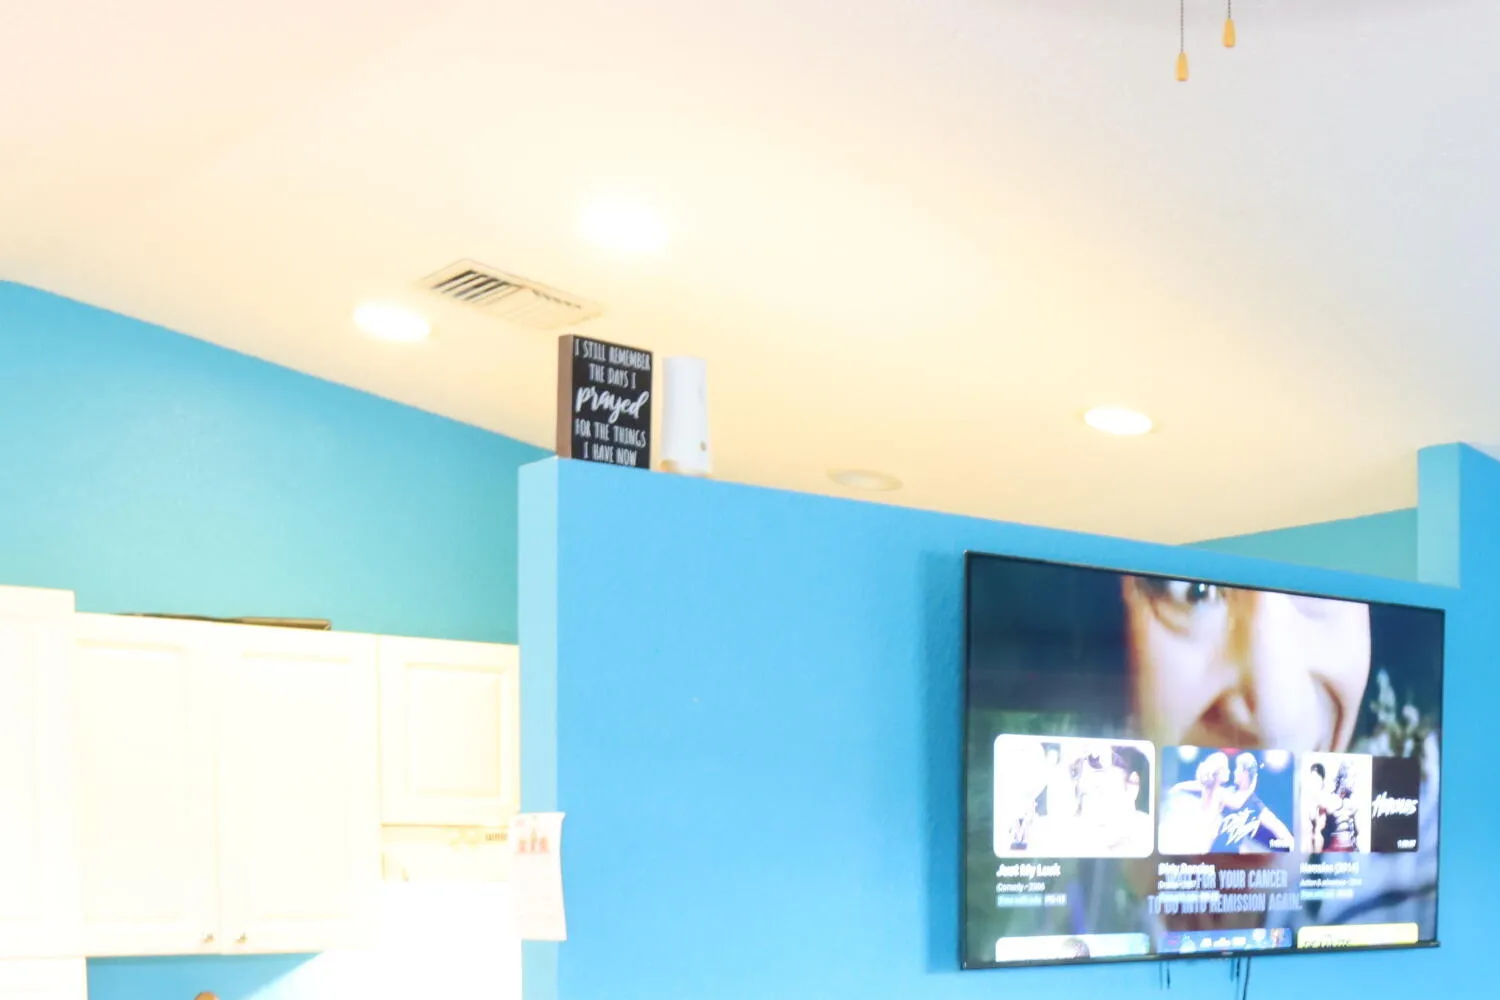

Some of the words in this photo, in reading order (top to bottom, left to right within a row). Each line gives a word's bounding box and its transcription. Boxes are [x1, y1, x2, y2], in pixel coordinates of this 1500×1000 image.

[575, 339, 580, 356] I
[583, 340, 606, 361] STILL
[609, 347, 650, 371] REMEMBER
[589, 363, 605, 382] THE
[608, 366, 629, 387] DAYS
[631, 372, 636, 389] I
[575, 385, 650, 424] prayed
[575, 418, 592, 438] FOR
[594, 421, 610, 442] THE
[613, 425, 647, 448] THINGS
[584, 442, 589, 459] I
[591, 443, 614, 464] HAVE
[616, 449, 638, 467] NOW
[1218, 869, 1246, 888] YOUR
[1248, 868, 1288, 888] CANCER
[1209, 892, 1266, 913] REMISSION
